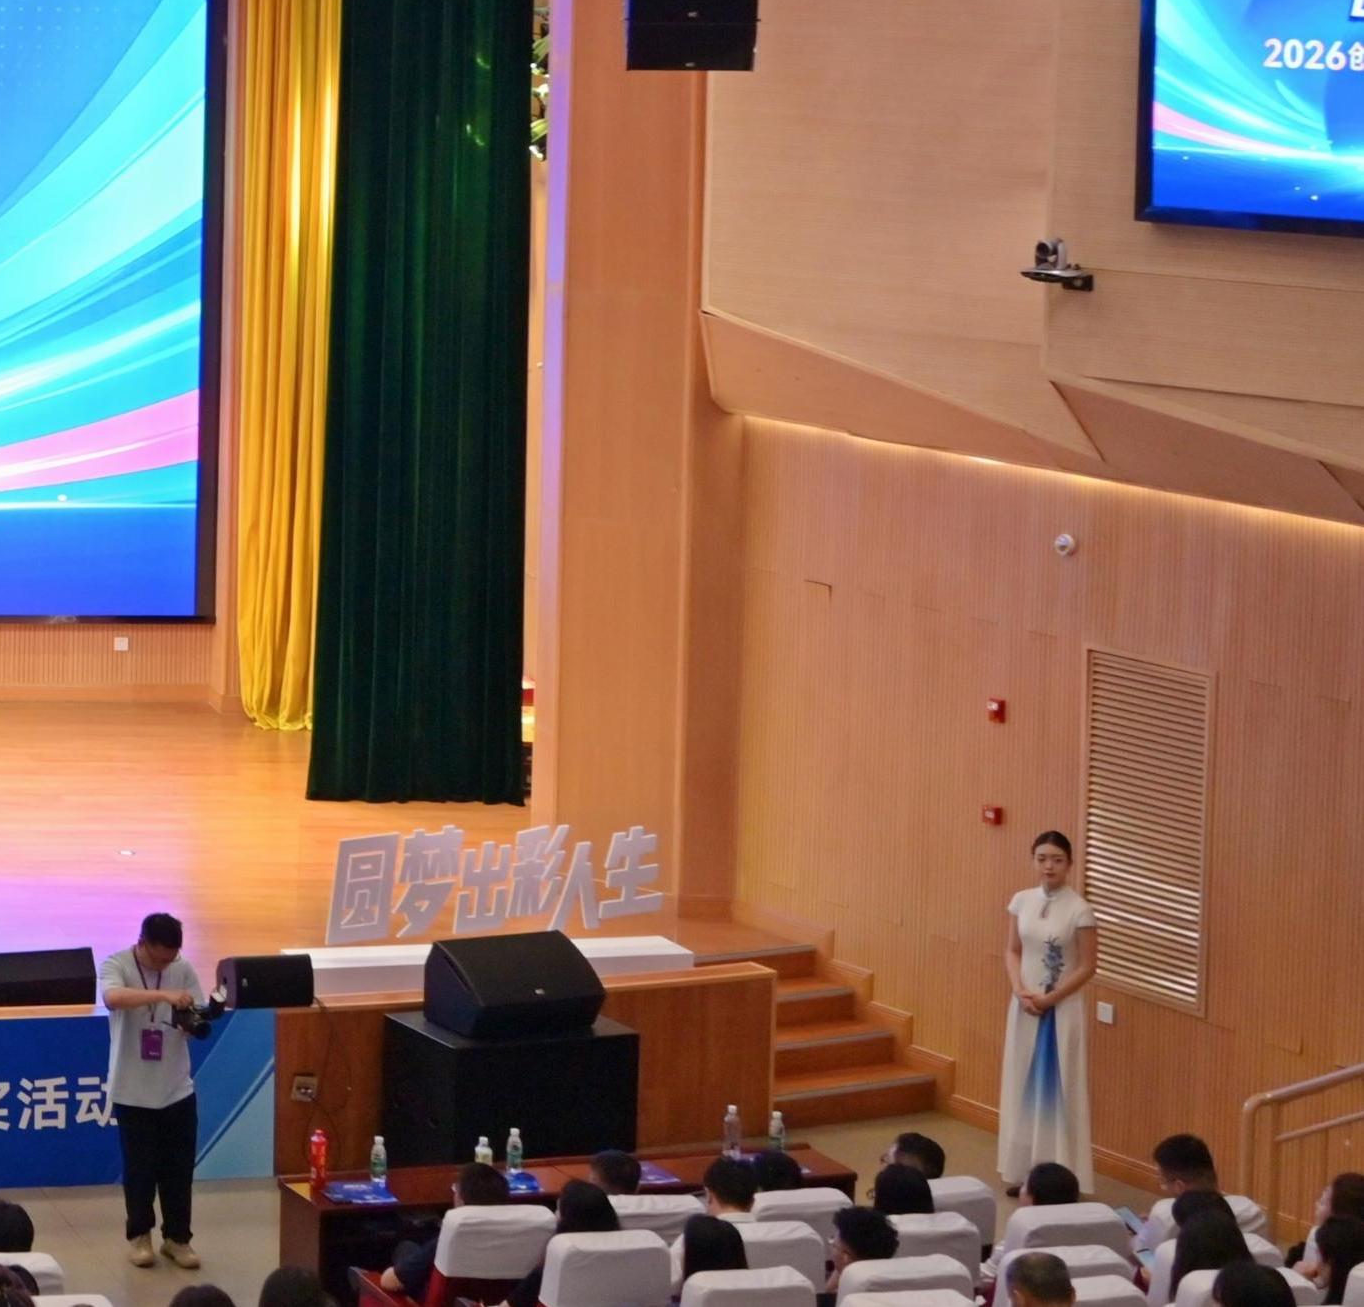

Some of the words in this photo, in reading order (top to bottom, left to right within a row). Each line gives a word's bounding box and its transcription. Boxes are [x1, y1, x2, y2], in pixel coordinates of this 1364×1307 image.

[325, 824, 663, 945] 圆梦出彩人生
